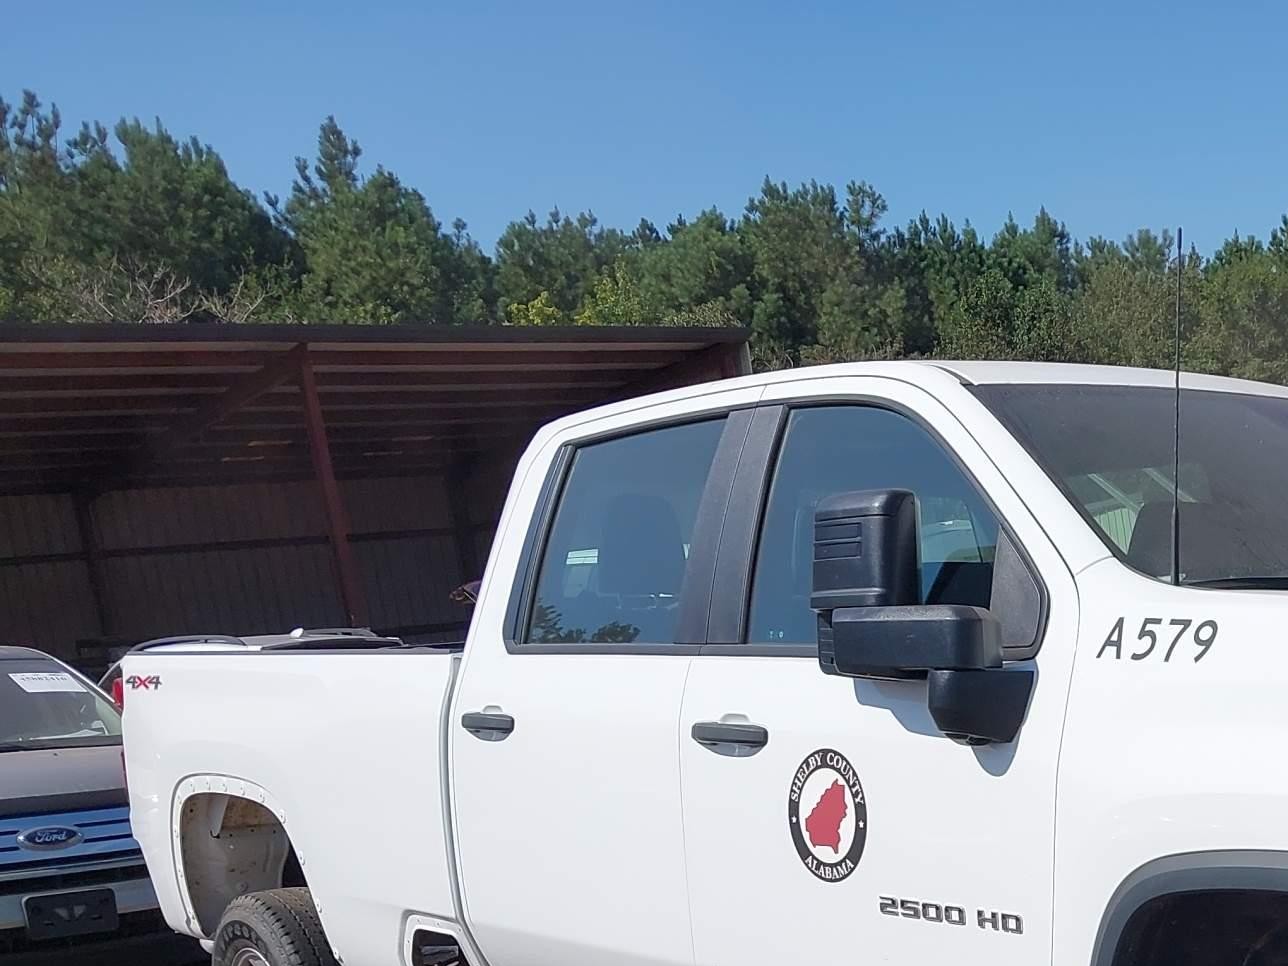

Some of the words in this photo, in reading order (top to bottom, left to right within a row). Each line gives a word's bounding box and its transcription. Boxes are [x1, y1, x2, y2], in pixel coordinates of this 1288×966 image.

[1096, 617, 1219, 663] A579
[790, 752, 823, 802] SHELBY
[826, 752, 865, 804] COUNTY
[35, 829, 67, 843] Ford
[804, 855, 855, 880] ALABAMA
[879, 895, 967, 926] 2500
[977, 908, 1024, 934] HD
